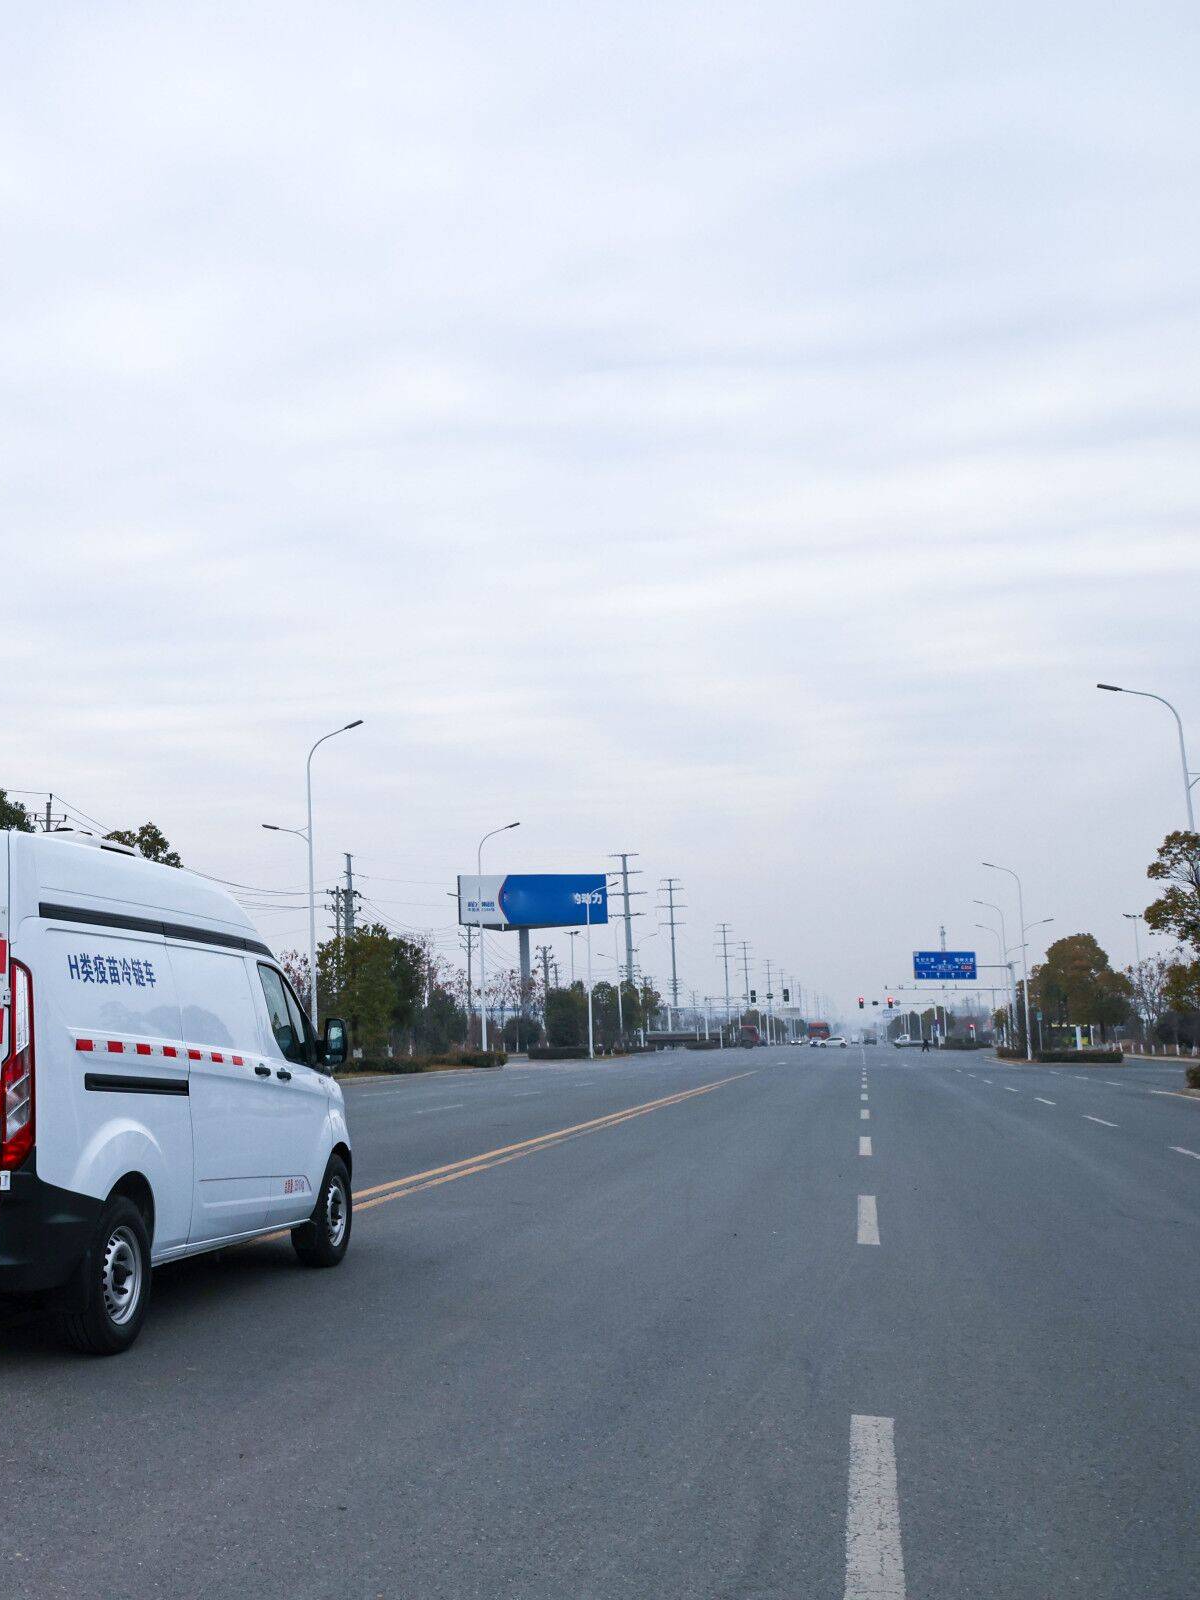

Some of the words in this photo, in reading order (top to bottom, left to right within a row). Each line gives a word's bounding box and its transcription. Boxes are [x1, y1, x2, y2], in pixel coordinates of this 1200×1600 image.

[67, 953, 156, 987] H类疫苗冷链车
